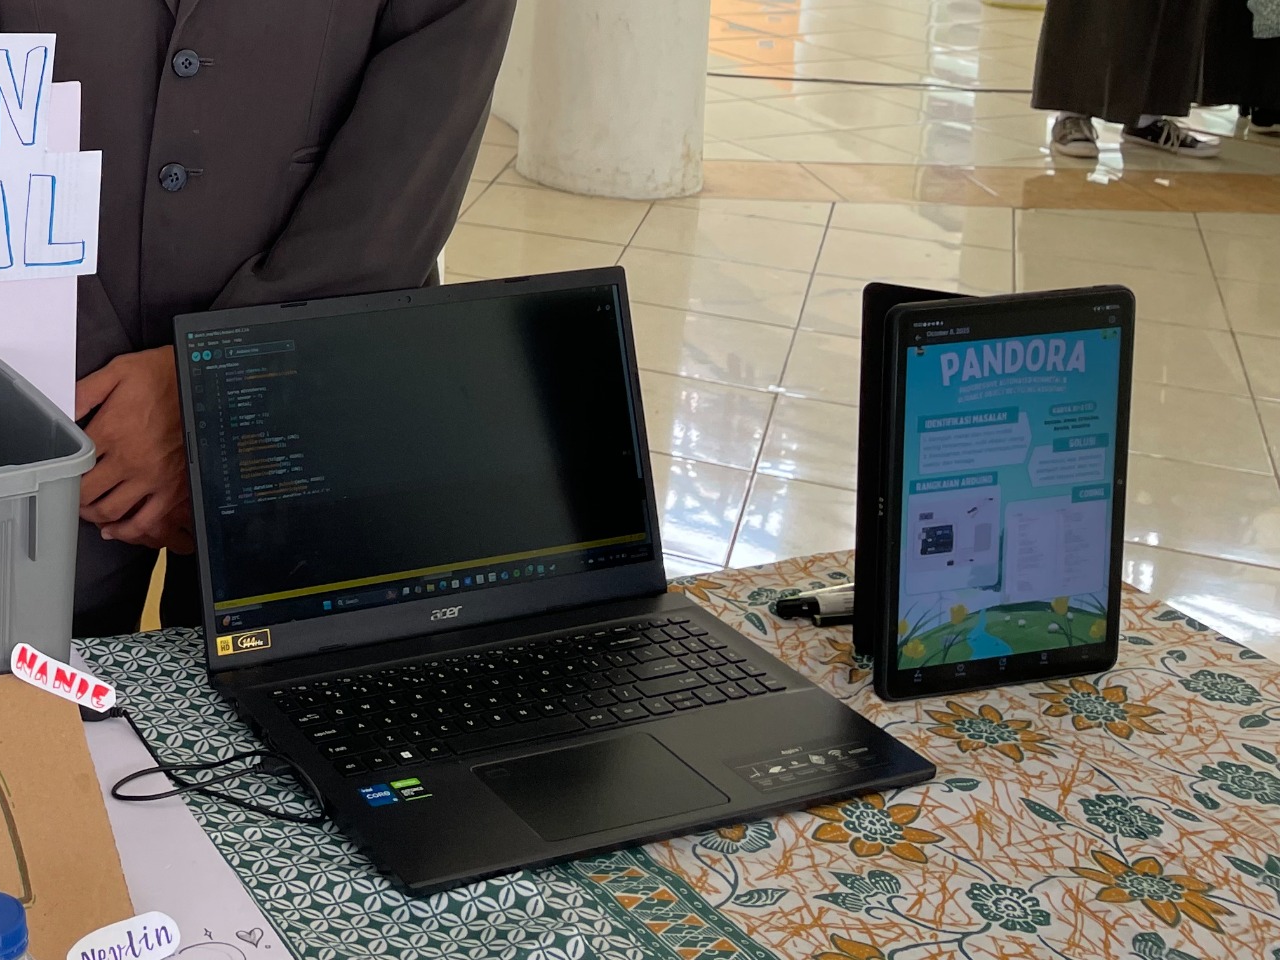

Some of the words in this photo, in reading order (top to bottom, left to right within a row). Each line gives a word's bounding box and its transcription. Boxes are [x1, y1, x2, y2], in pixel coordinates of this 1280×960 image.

[939, 338, 1086, 387] PANDORA
[924, 414, 972, 429] IDENTIFIKASI
[972, 412, 1009, 425] MASALAH
[1068, 437, 1097, 449] SOLUSI
[915, 479, 960, 492] RANGKAIAN
[960, 475, 994, 487] ARDUINO
[430, 605, 463, 621] acer
[220, 643, 231, 652] HD
